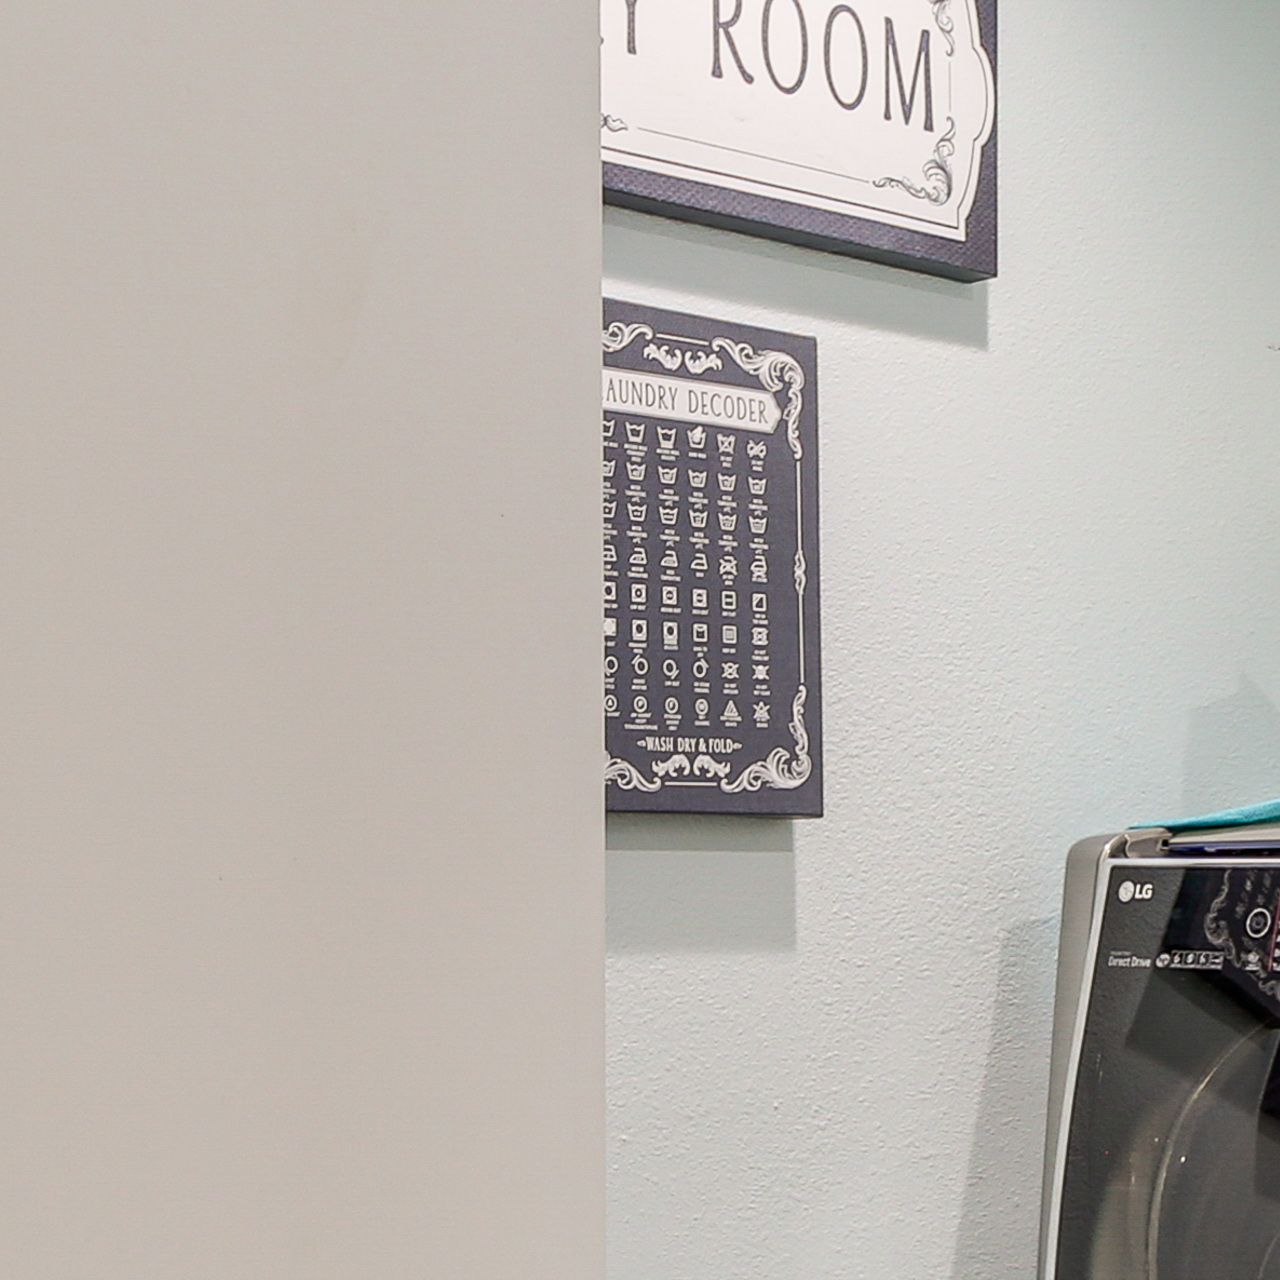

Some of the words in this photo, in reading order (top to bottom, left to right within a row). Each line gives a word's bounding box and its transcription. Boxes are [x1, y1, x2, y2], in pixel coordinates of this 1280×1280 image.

[711, 0, 934, 132] ROOM
[605, 377, 679, 411] AUNDRY
[688, 389, 769, 425] DECODER
[645, 736, 675, 752] WASH
[677, 737, 697, 753] DRY
[698, 737, 707, 752] &
[708, 738, 733, 754] FOLD
[1134, 883, 1153, 900] LG
